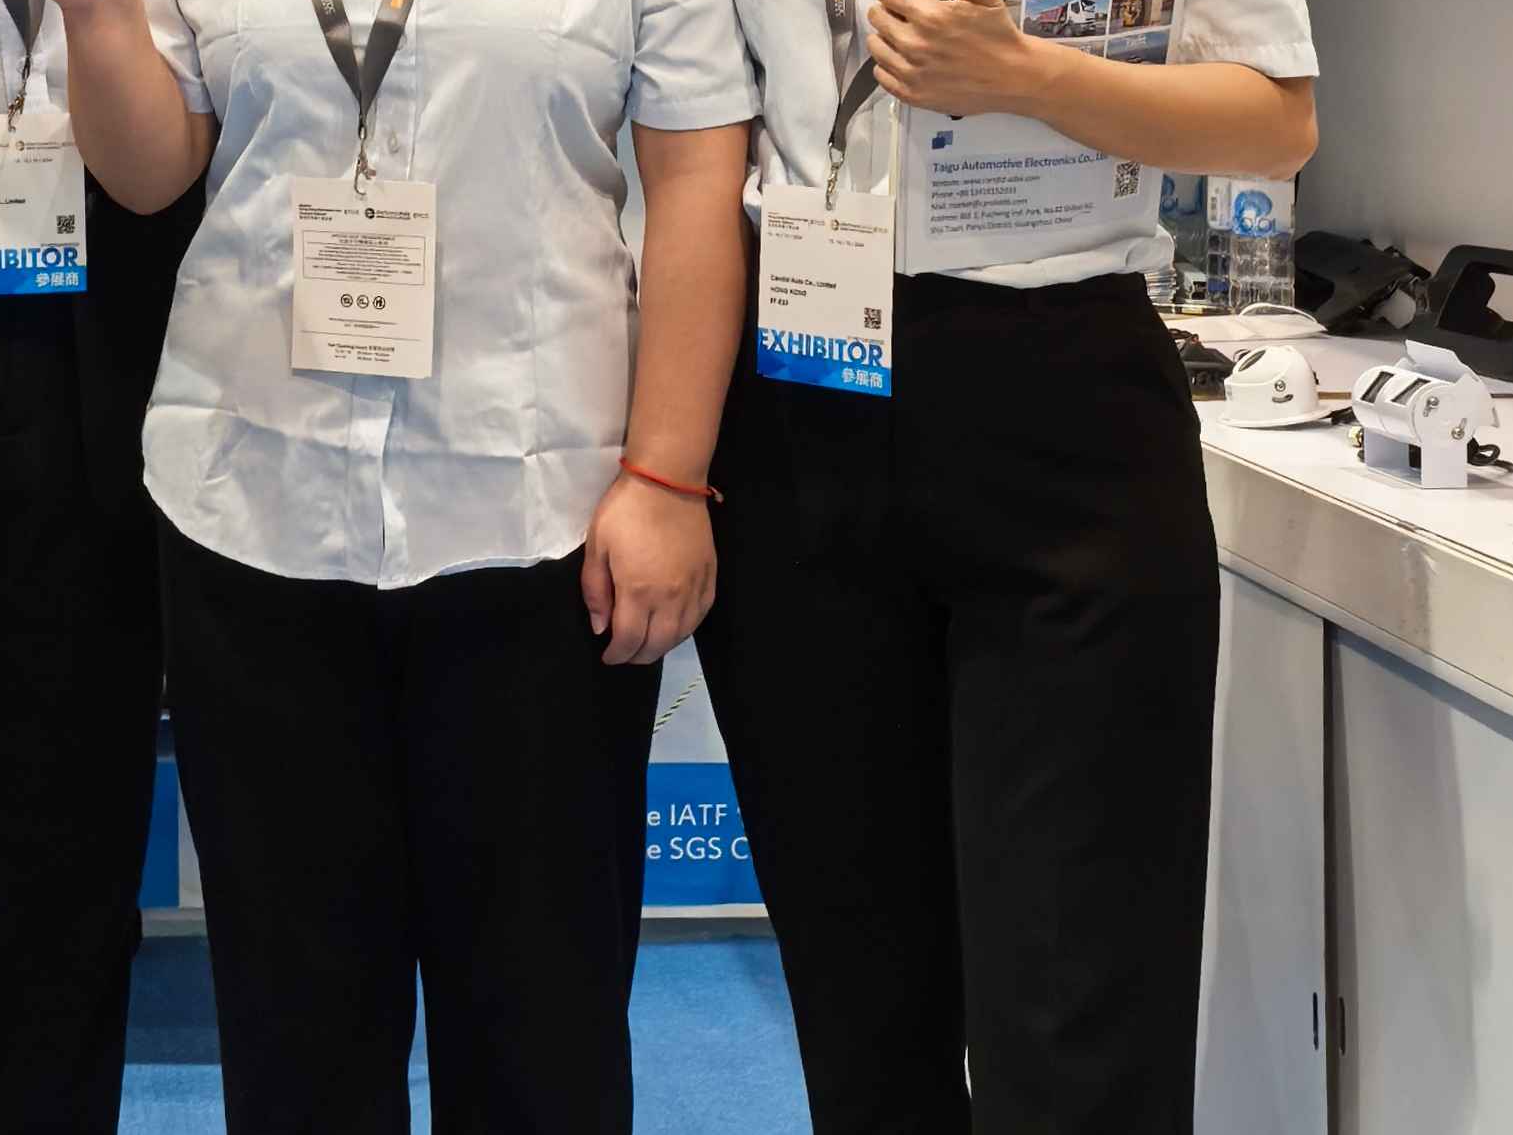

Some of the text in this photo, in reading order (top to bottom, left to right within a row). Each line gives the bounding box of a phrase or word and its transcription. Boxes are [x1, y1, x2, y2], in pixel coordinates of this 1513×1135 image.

[933, 155, 1076, 173] Taigu Automotive Electronics
[758, 328, 883, 366] EXHIBITOR
[670, 803, 727, 827] IATF
[670, 836, 722, 860] SGS
